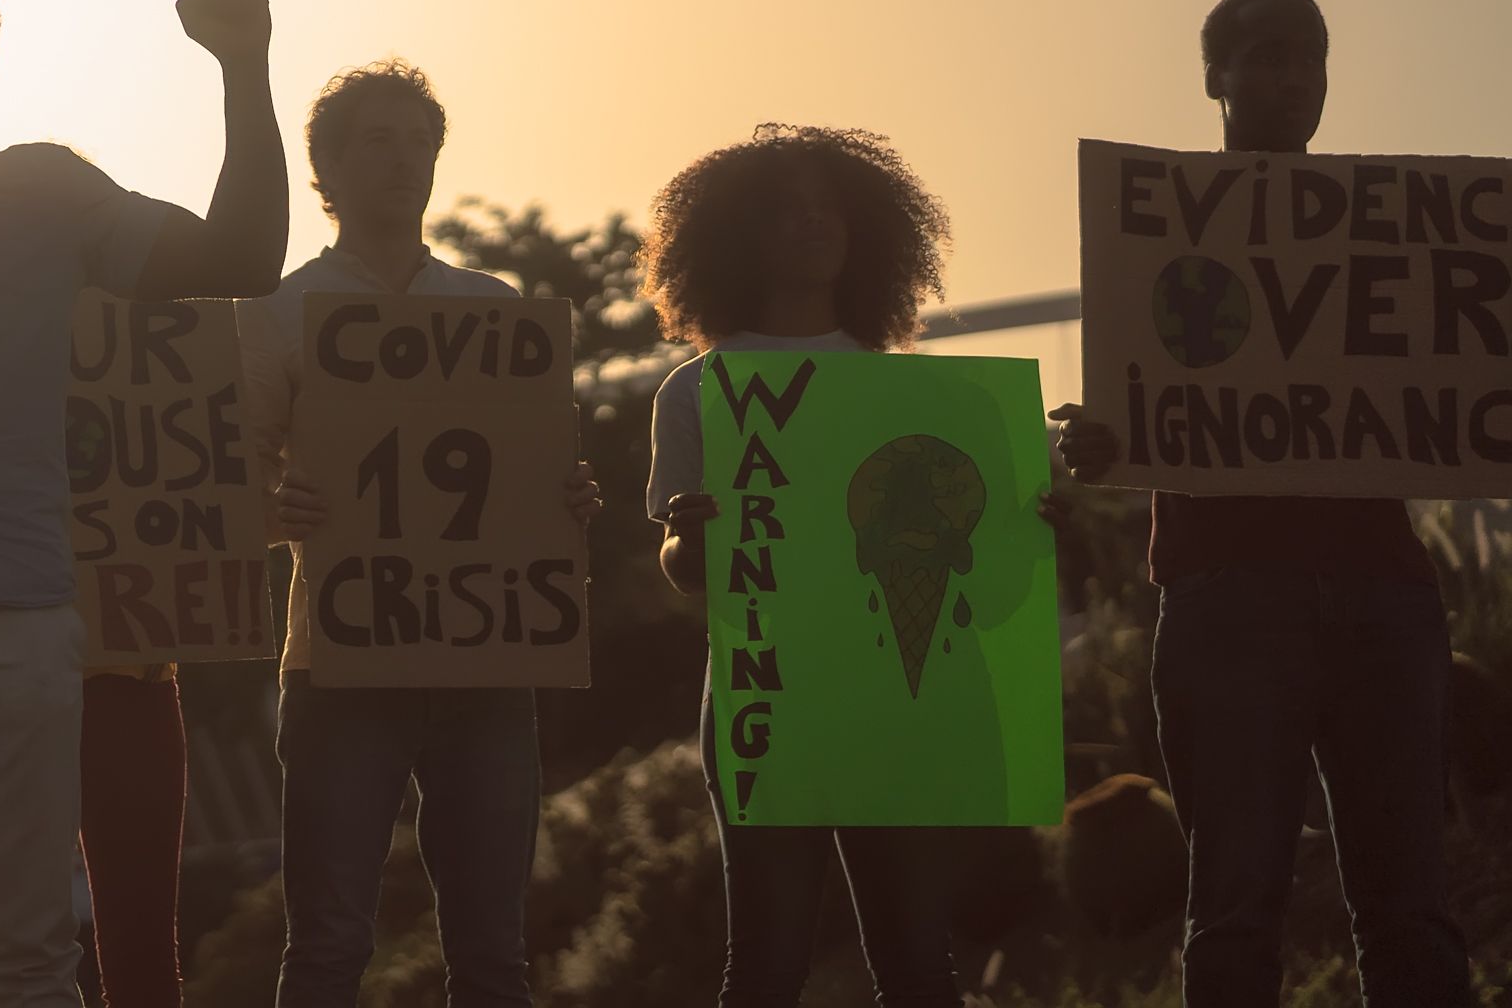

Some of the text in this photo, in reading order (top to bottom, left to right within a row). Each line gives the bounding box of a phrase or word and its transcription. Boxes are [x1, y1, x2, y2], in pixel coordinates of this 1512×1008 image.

[1120, 158, 1509, 248] EViDENC
[69, 301, 200, 386] UR
[1126, 360, 1512, 469] iGNORANC
[72, 498, 227, 562] S ON
[355, 426, 493, 542] 19
[93, 558, 265, 653] RE!!
